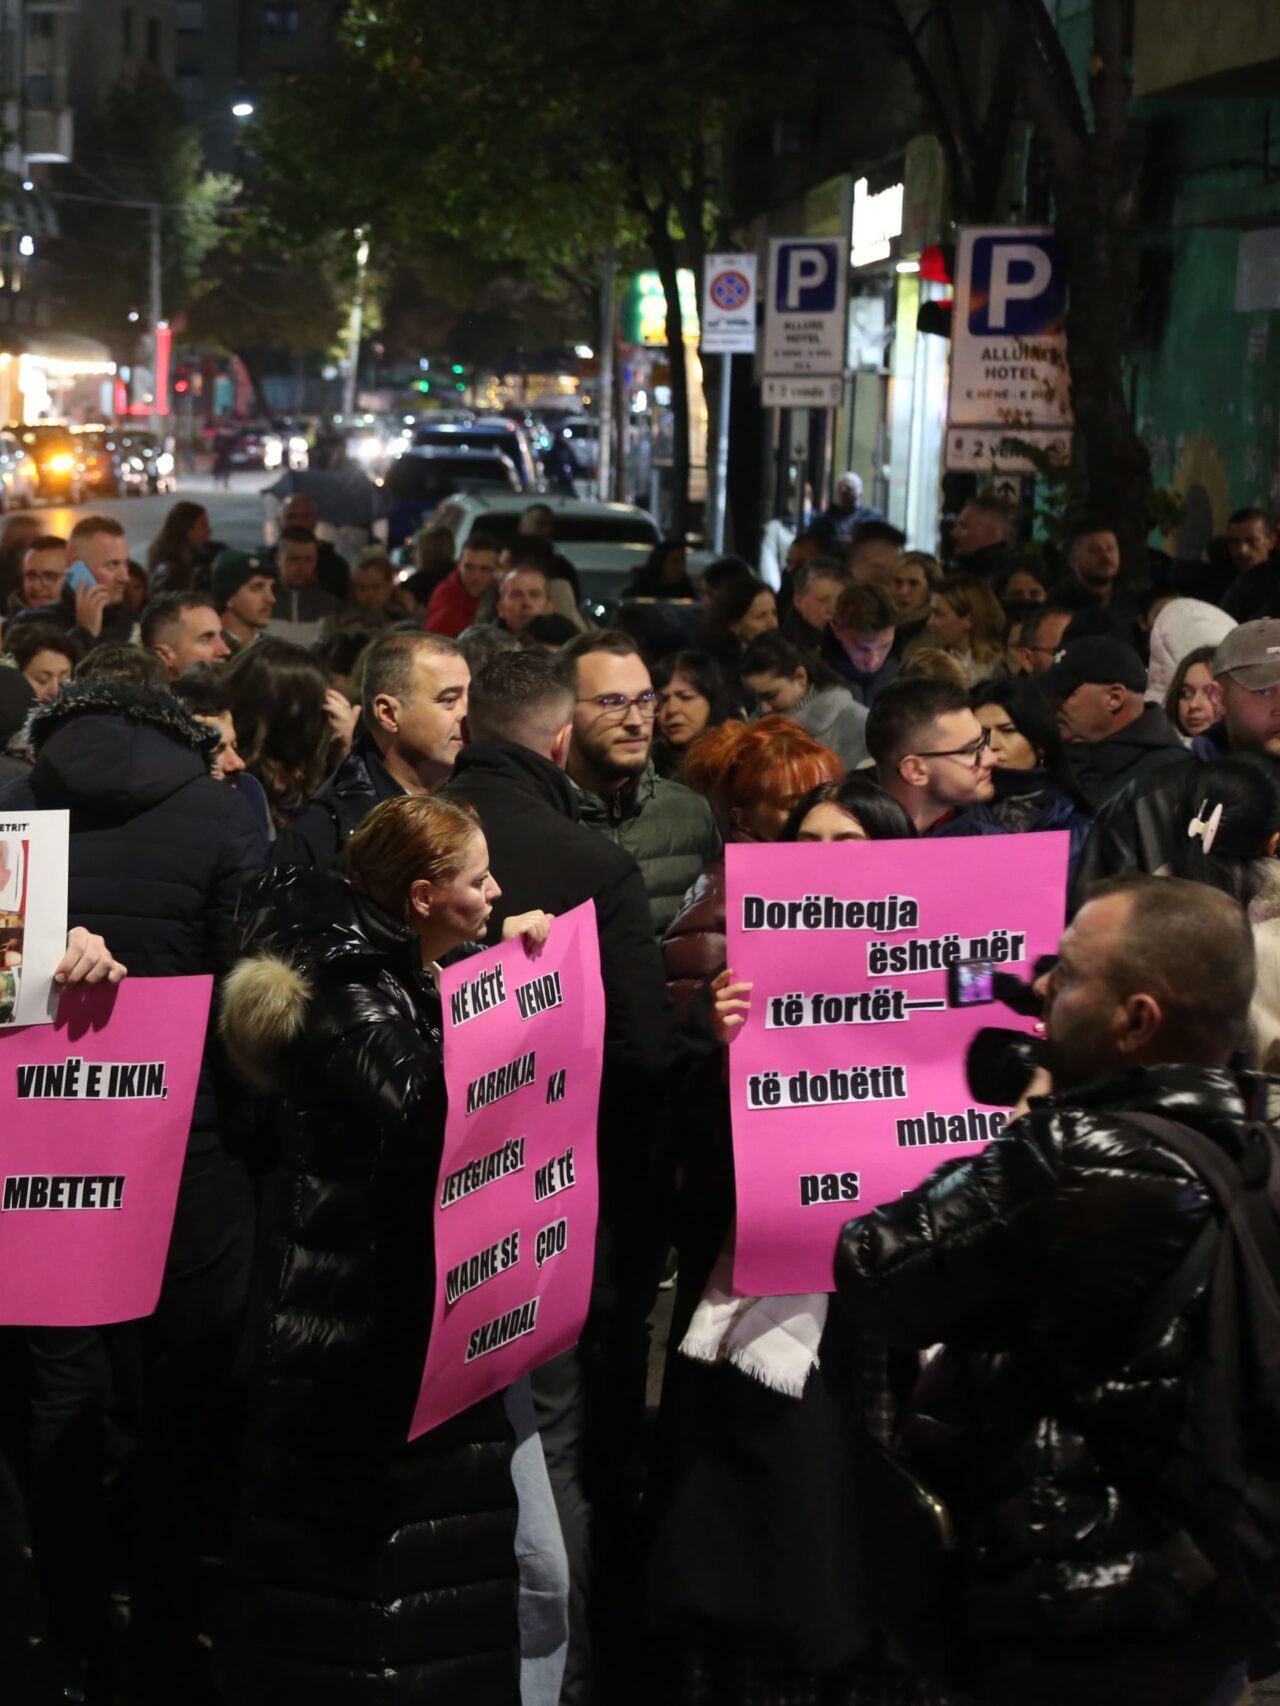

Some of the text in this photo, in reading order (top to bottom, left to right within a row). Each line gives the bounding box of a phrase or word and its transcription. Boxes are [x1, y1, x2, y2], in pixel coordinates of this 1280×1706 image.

[787, 249, 829, 309] P
[987, 243, 1053, 329] P
[785, 333, 820, 343] HOTEL
[981, 346, 1045, 362] ALLU
[985, 366, 1039, 381] HOTEL
[973, 440, 983, 458] 2
[743, 895, 918, 931] Dorëheqja
[869, 935, 961, 974] është
[451, 963, 563, 1025] NË KËTË VEND!
[771, 994, 804, 1027] të
[17, 1059, 82, 1098] VINË
[86, 1065, 102, 1097] E
[107, 1062, 168, 1099] IKIN,
[466, 1051, 566, 1114] KARRIKJA KA
[749, 1066, 906, 1106] të dobëtit
[896, 1109, 1012, 1147] mbahe
[441, 1137, 575, 1206] JETËGJATËSI MË TË
[800, 1172, 859, 1205] pas
[3, 1176, 125, 1210] MBETET!
[446, 1220, 566, 1301] MADHE SE ÇDO
[467, 1300, 537, 1360] SKANDAL
